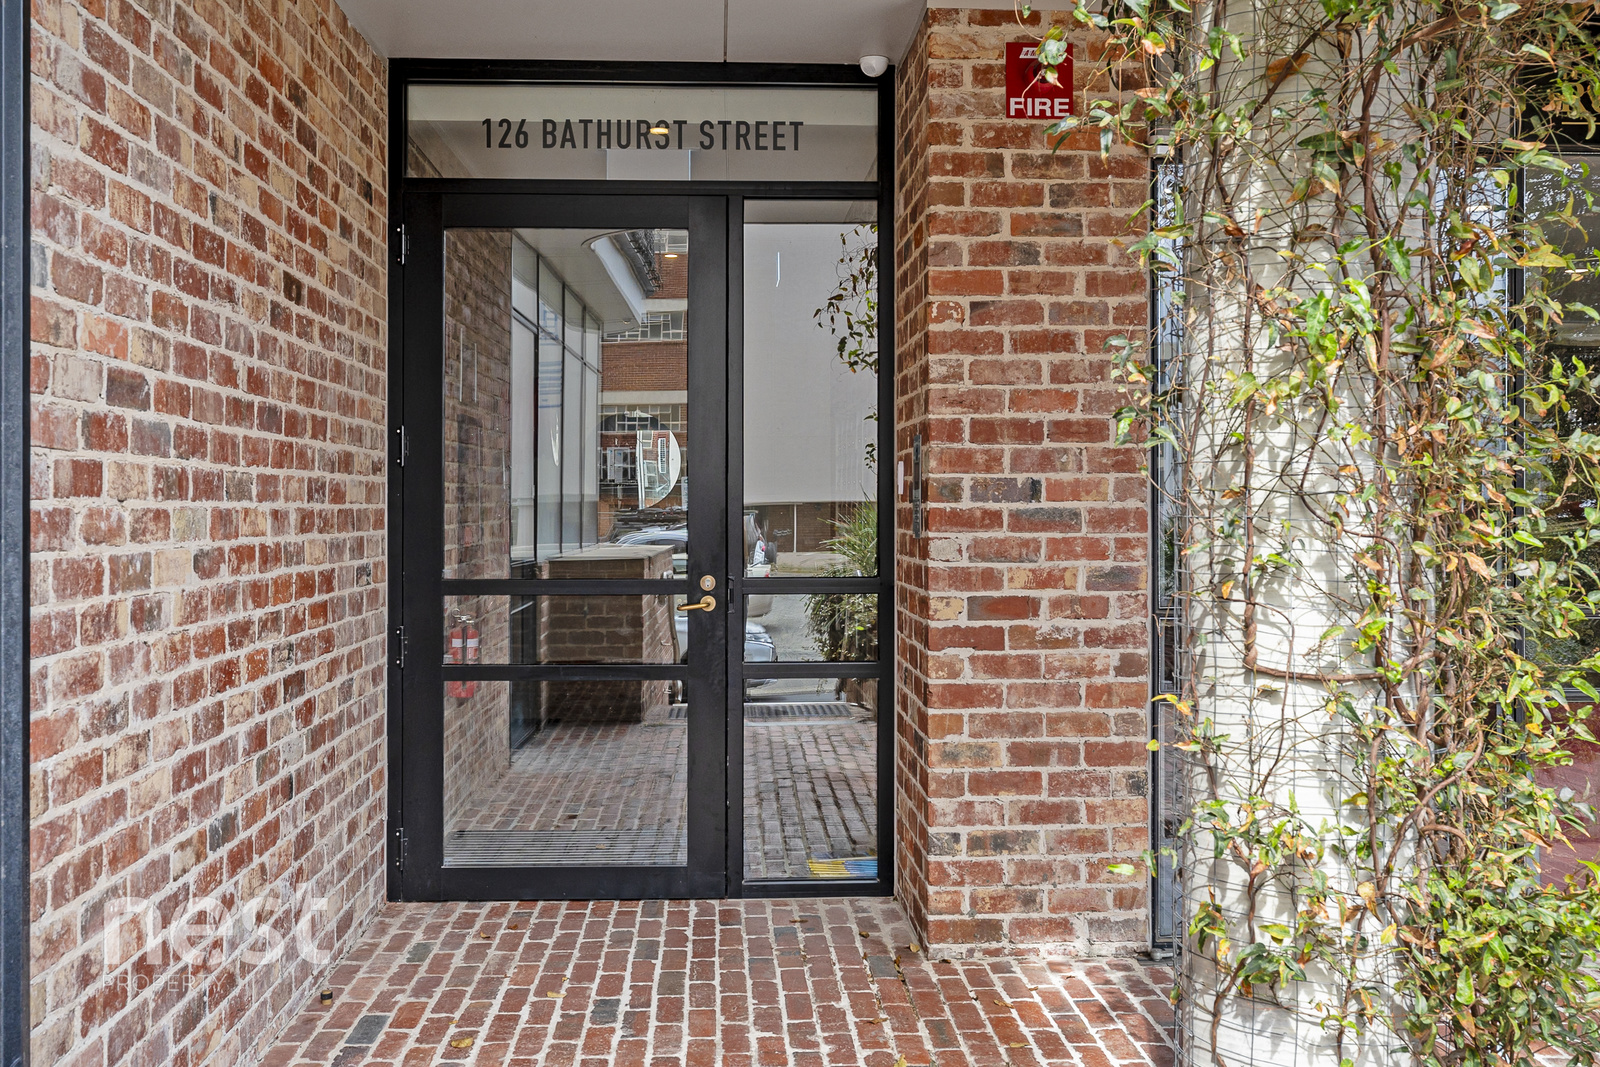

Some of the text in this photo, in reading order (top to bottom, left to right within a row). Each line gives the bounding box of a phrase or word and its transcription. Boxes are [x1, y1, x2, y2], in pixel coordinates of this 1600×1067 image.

[1009, 97, 1070, 117] FIRE
[482, 118, 804, 151] 126 BATHURST STREET
